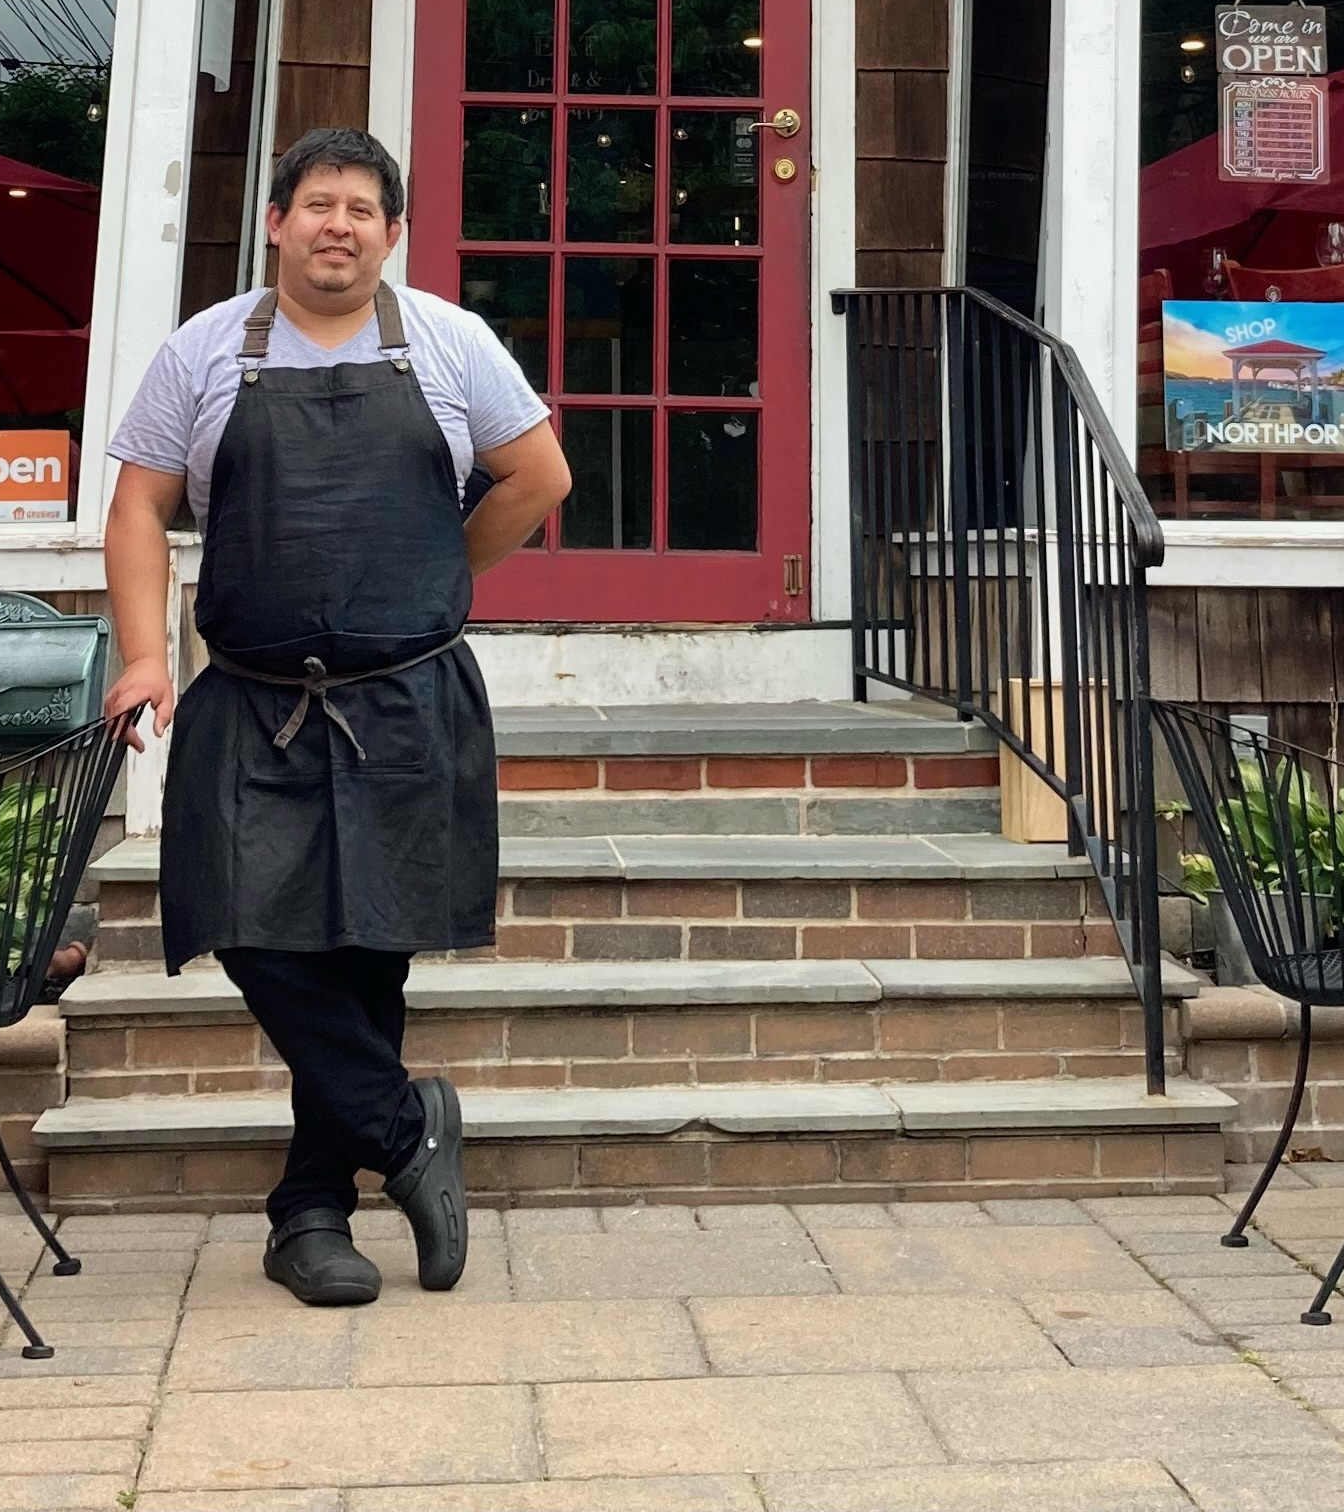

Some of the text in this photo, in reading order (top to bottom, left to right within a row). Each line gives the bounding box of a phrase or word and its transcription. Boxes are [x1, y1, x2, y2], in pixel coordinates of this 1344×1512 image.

[1218, 10, 1323, 40] Come in
[1248, 35, 1299, 44] we are
[1222, 44, 1323, 73] OPEN
[528, 69, 582, 87] Drk
[1236, 88, 1312, 99] BUSINESS HOURS
[1251, 168, 1276, 178] Thank
[1225, 317, 1276, 344] SHOP
